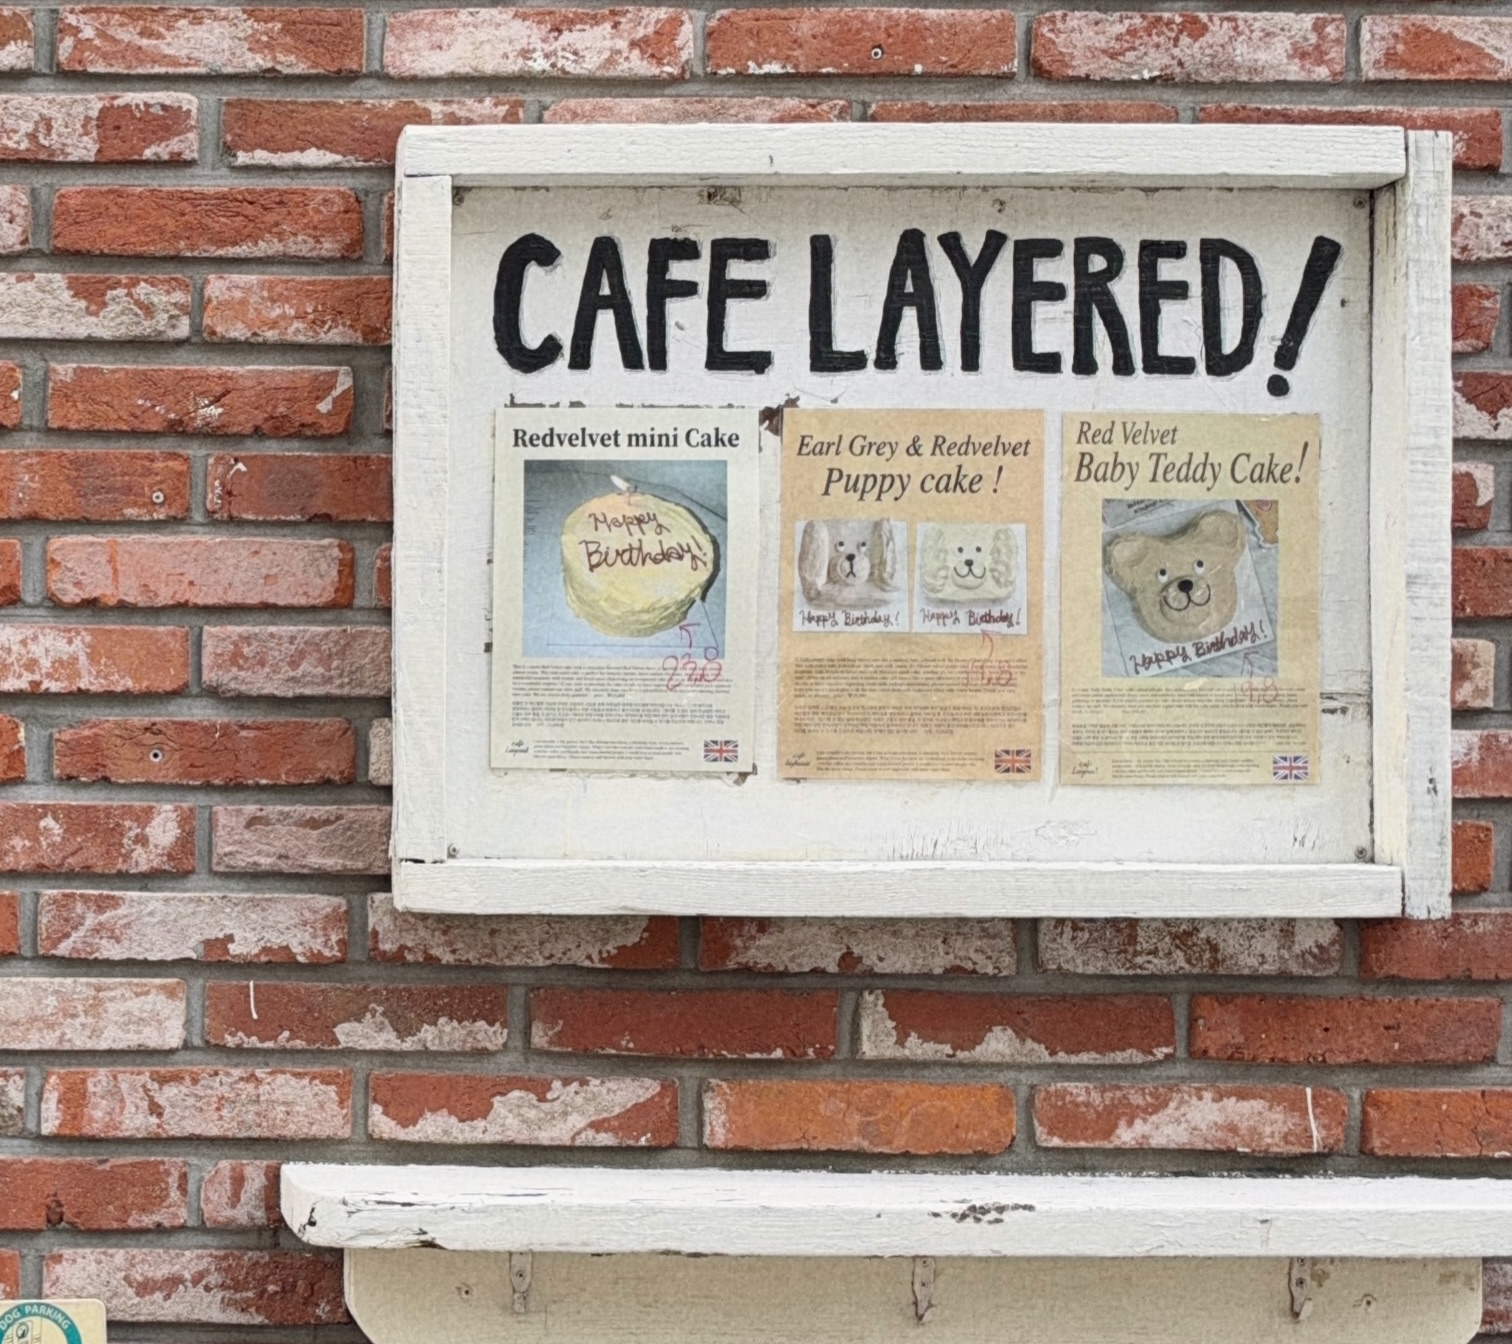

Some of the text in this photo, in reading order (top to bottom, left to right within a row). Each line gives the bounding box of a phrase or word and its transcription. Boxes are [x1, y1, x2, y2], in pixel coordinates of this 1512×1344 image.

[492, 227, 1344, 399] CAFE LAYERED!
[512, 427, 740, 449] Redvelvet mini Cake
[1076, 421, 1178, 445] Red Velvet
[797, 434, 1032, 464] Earl Grey & Redvelvet
[1074, 440, 1309, 491] Baby Teddy Cake!
[822, 464, 984, 501] Puppy cake
[588, 510, 671, 535] Happy
[798, 609, 838, 628] Happy
[919, 608, 960, 627] Happy
[1129, 645, 1192, 675] Happy
[24, 1304, 72, 1330] PARKING
